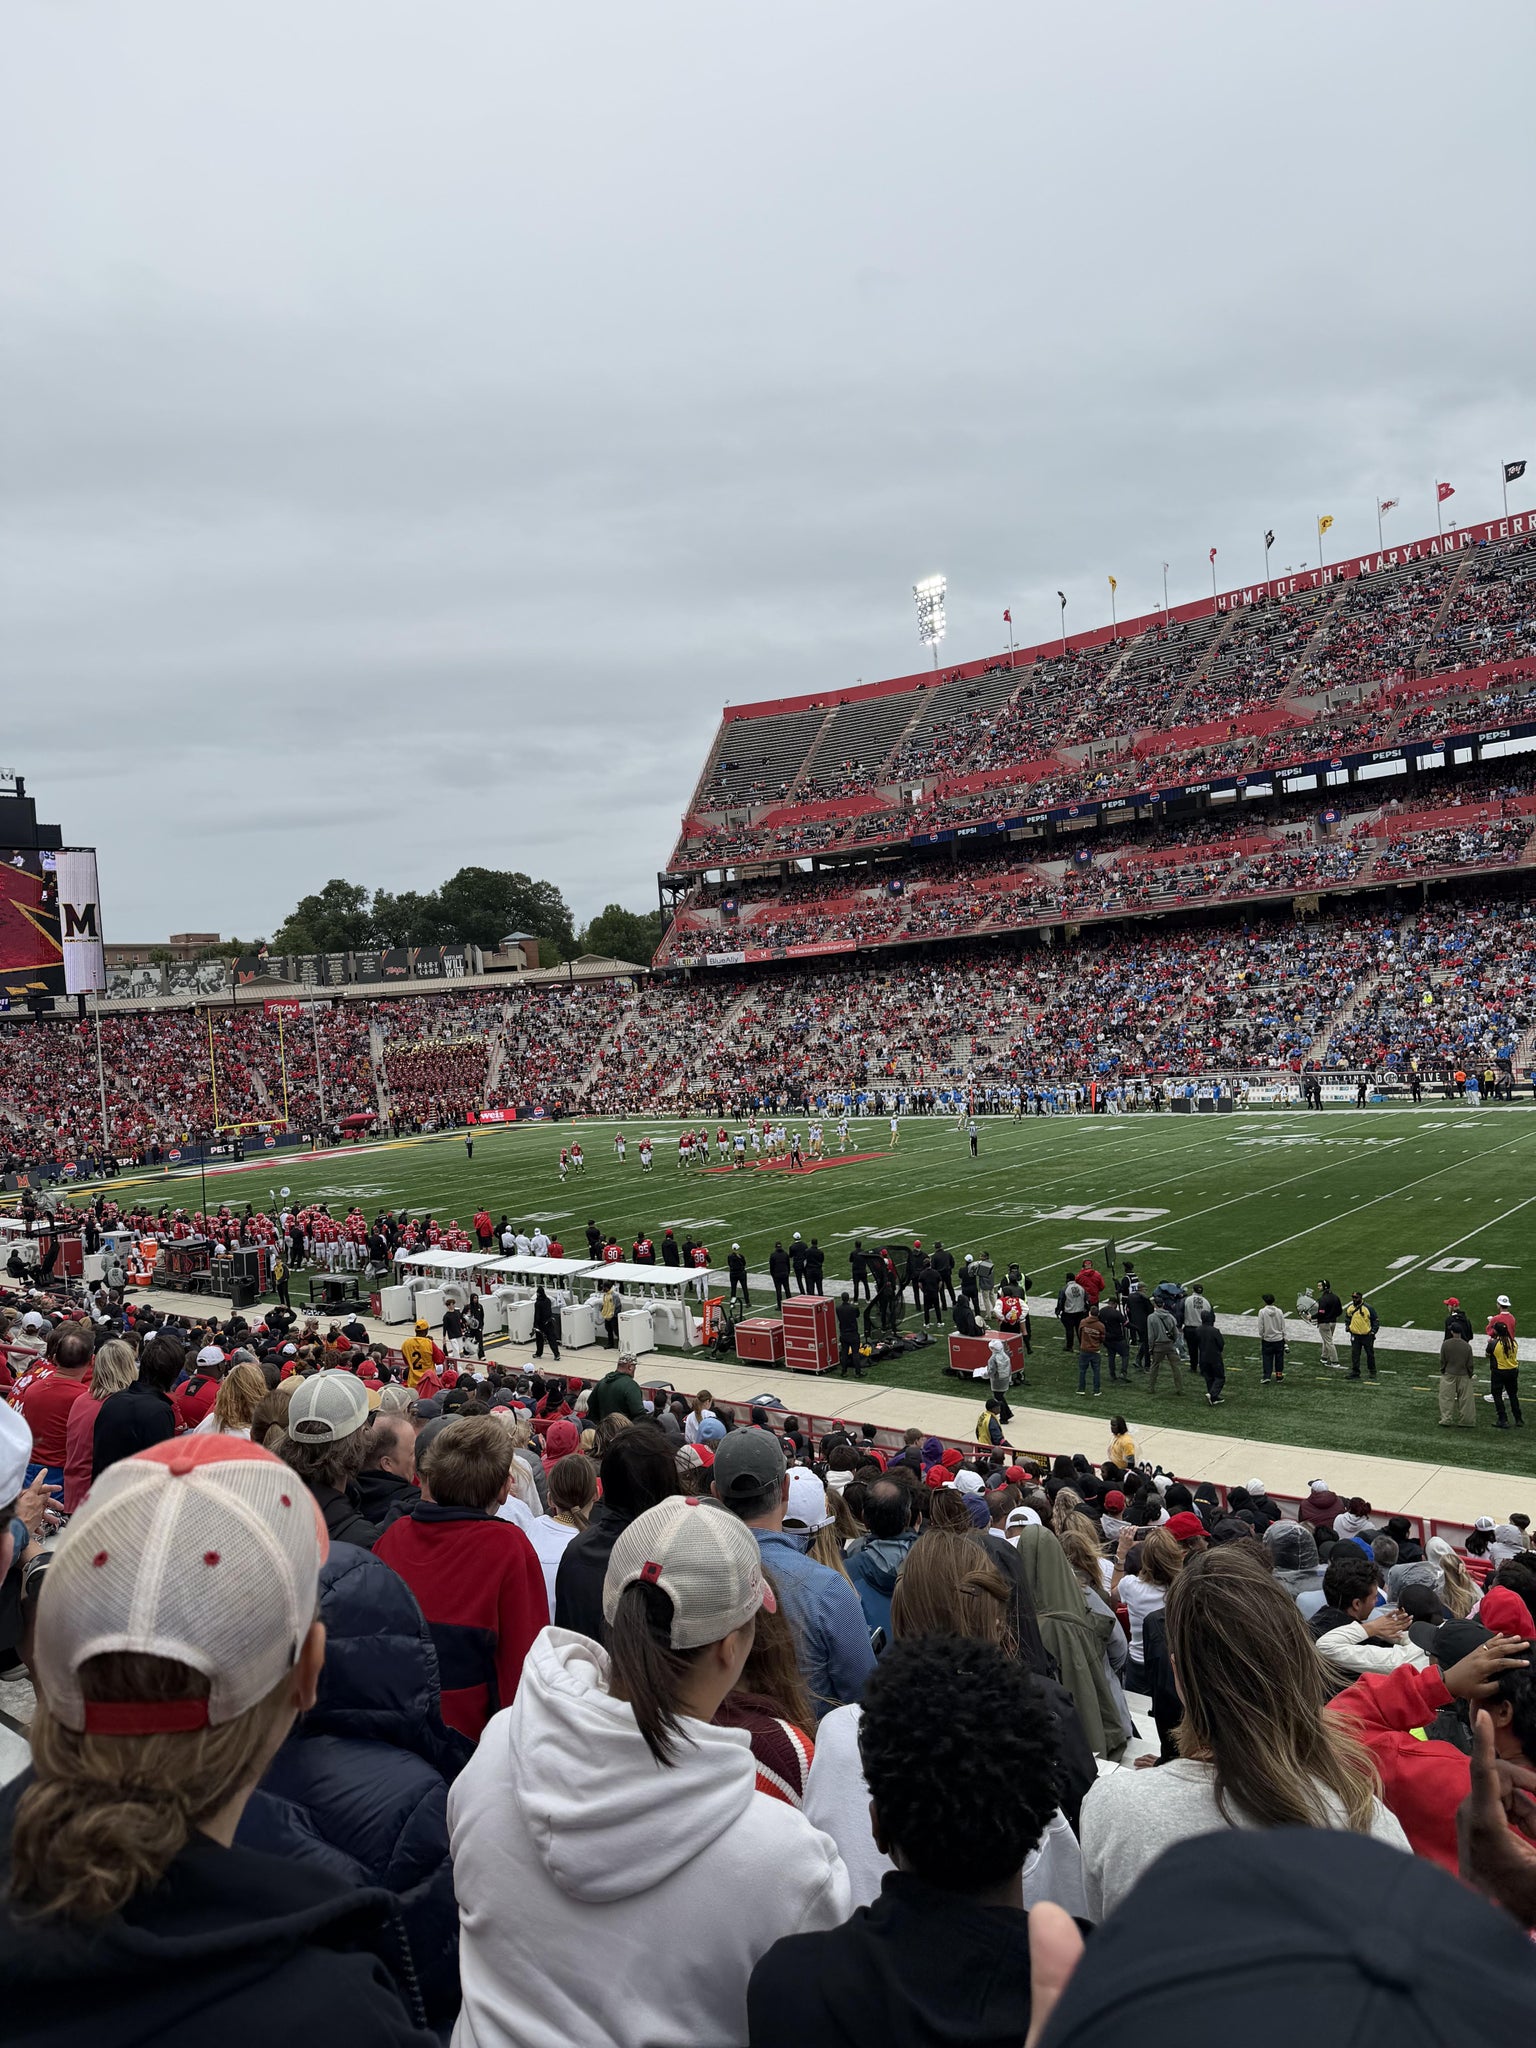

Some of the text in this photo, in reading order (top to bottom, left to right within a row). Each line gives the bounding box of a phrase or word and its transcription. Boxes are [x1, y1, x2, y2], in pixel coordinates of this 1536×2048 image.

[1218, 587, 1264, 609] HOME
[1277, 578, 1297, 597] OF
[1359, 532, 1471, 574] MARYLAND
[1478, 729, 1511, 742] PEPSI
[1372, 749, 1402, 761] PEPSI
[1275, 768, 1302, 778] PEPSI
[1185, 784, 1210, 794] PEPSI
[1101, 800, 1126, 809] PEPSI
[1026, 815, 1048, 823] PEPSI
[957, 827, 977, 836] PEPSI
[62, 903, 99, 937] M
[444, 960, 464, 969] WILL
[709, 956, 739, 964] BlueAlly
[267, 1003, 297, 1014] Terps
[480, 1110, 504, 1119] weis
[16, 1175, 31, 1188] M
[639, 1245, 649, 1255] 95
[1059, 1238, 1158, 1254] 20
[607, 1250, 618, 1260] 90
[694, 1253, 705, 1263] 38
[1385, 1254, 1482, 1273] 10
[411, 1351, 423, 1371] 2
